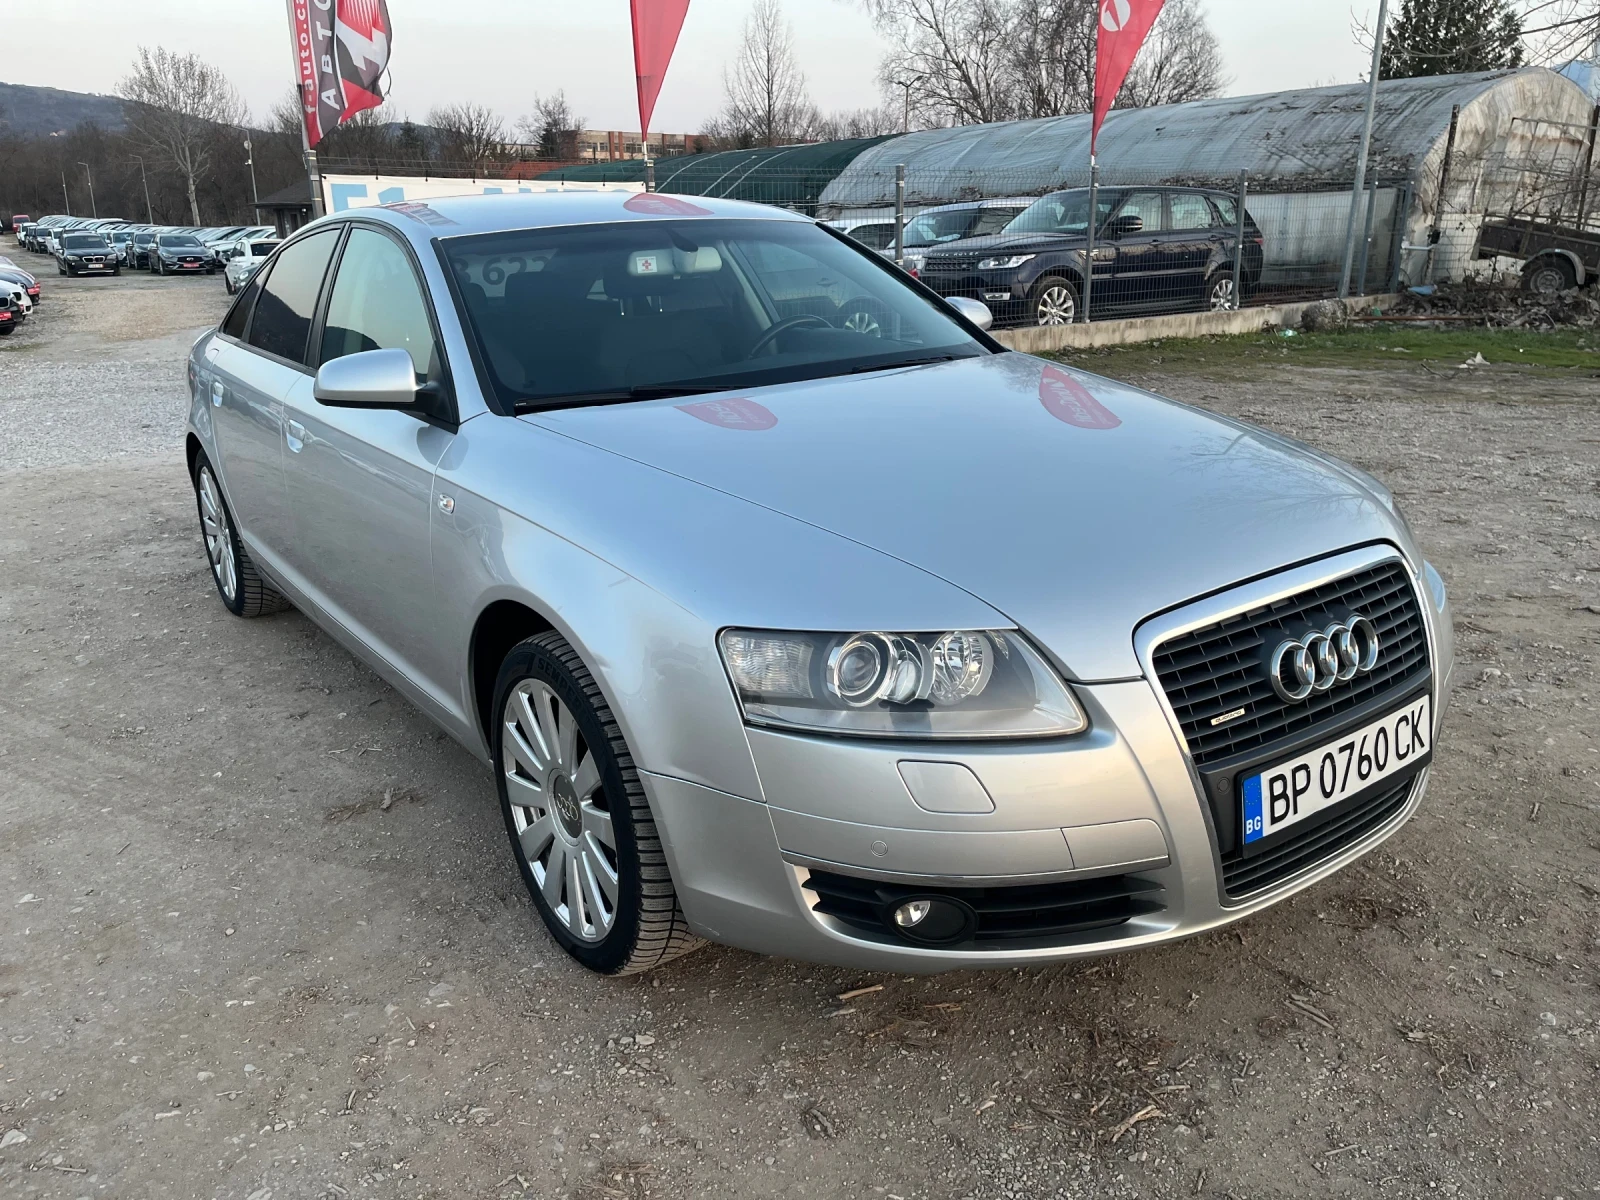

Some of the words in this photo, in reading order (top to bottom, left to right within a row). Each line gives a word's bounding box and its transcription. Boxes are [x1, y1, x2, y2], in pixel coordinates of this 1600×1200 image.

[1269, 763, 1311, 826] BP
[1319, 726, 1389, 799] 0760
[1395, 704, 1426, 761] CK
[1246, 816, 1262, 835] BG
